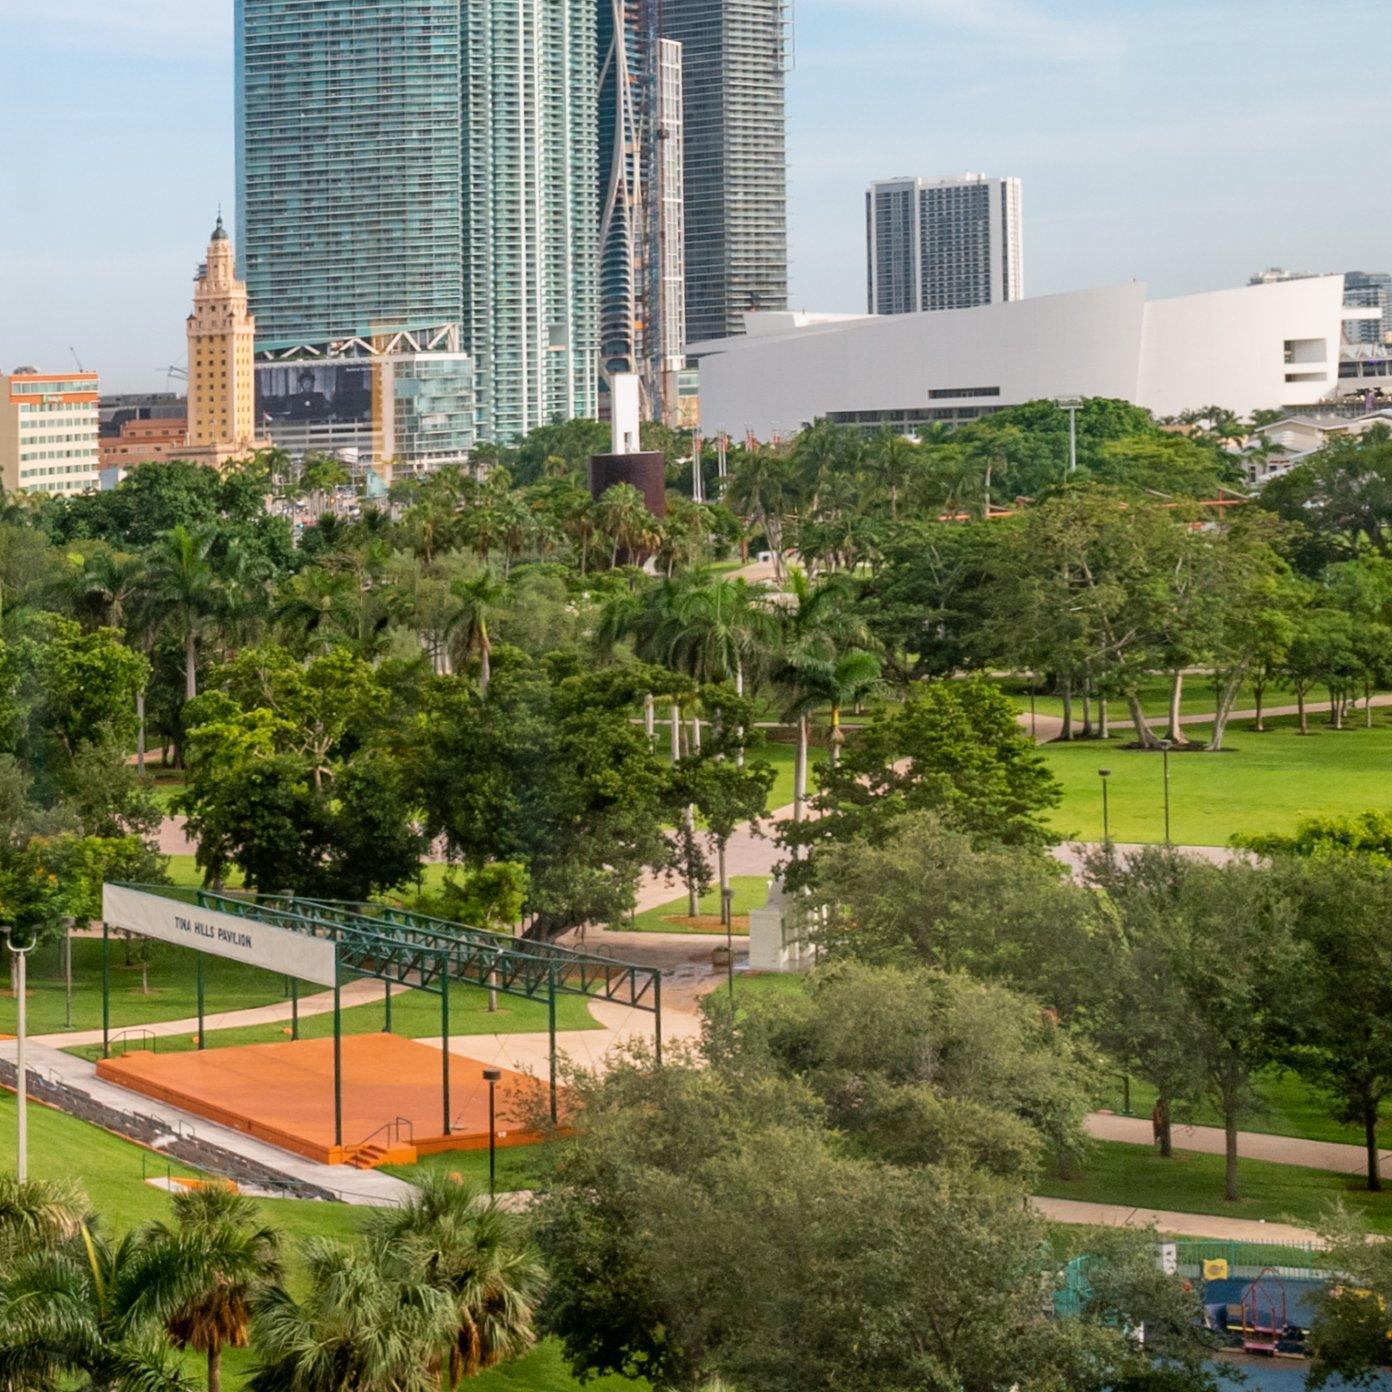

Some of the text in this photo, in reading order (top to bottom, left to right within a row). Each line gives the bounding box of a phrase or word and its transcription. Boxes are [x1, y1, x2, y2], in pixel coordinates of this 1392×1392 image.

[175, 916, 252, 948] TINA HILLS PAVILION
